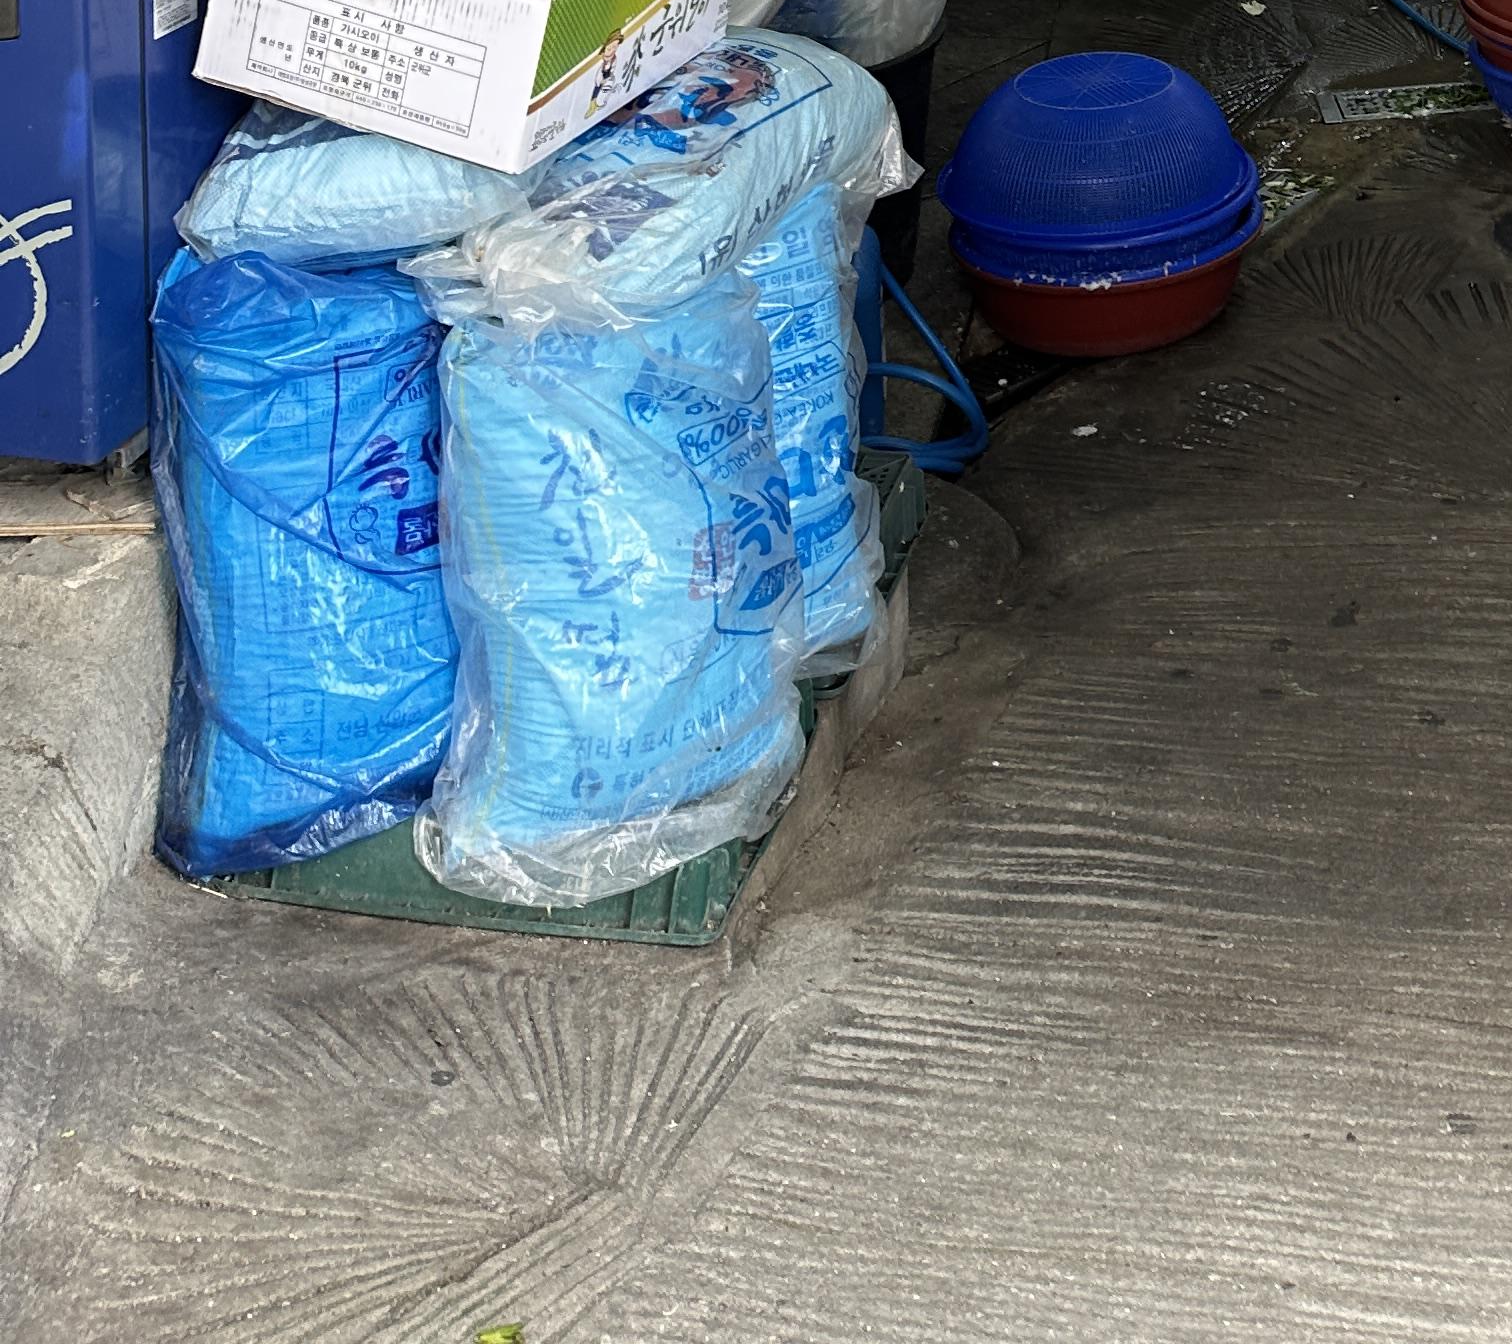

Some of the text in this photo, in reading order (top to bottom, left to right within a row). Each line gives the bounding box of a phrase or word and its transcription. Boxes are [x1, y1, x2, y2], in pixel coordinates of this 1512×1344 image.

[339, 19, 381, 44] 가시오이
[305, 46, 325, 62] 무게
[343, 58, 368, 76] 10kg
[387, 53, 407, 69] 주소
[302, 61, 322, 78] 산지
[352, 78, 373, 94] 군위
[381, 86, 401, 102] 전화
